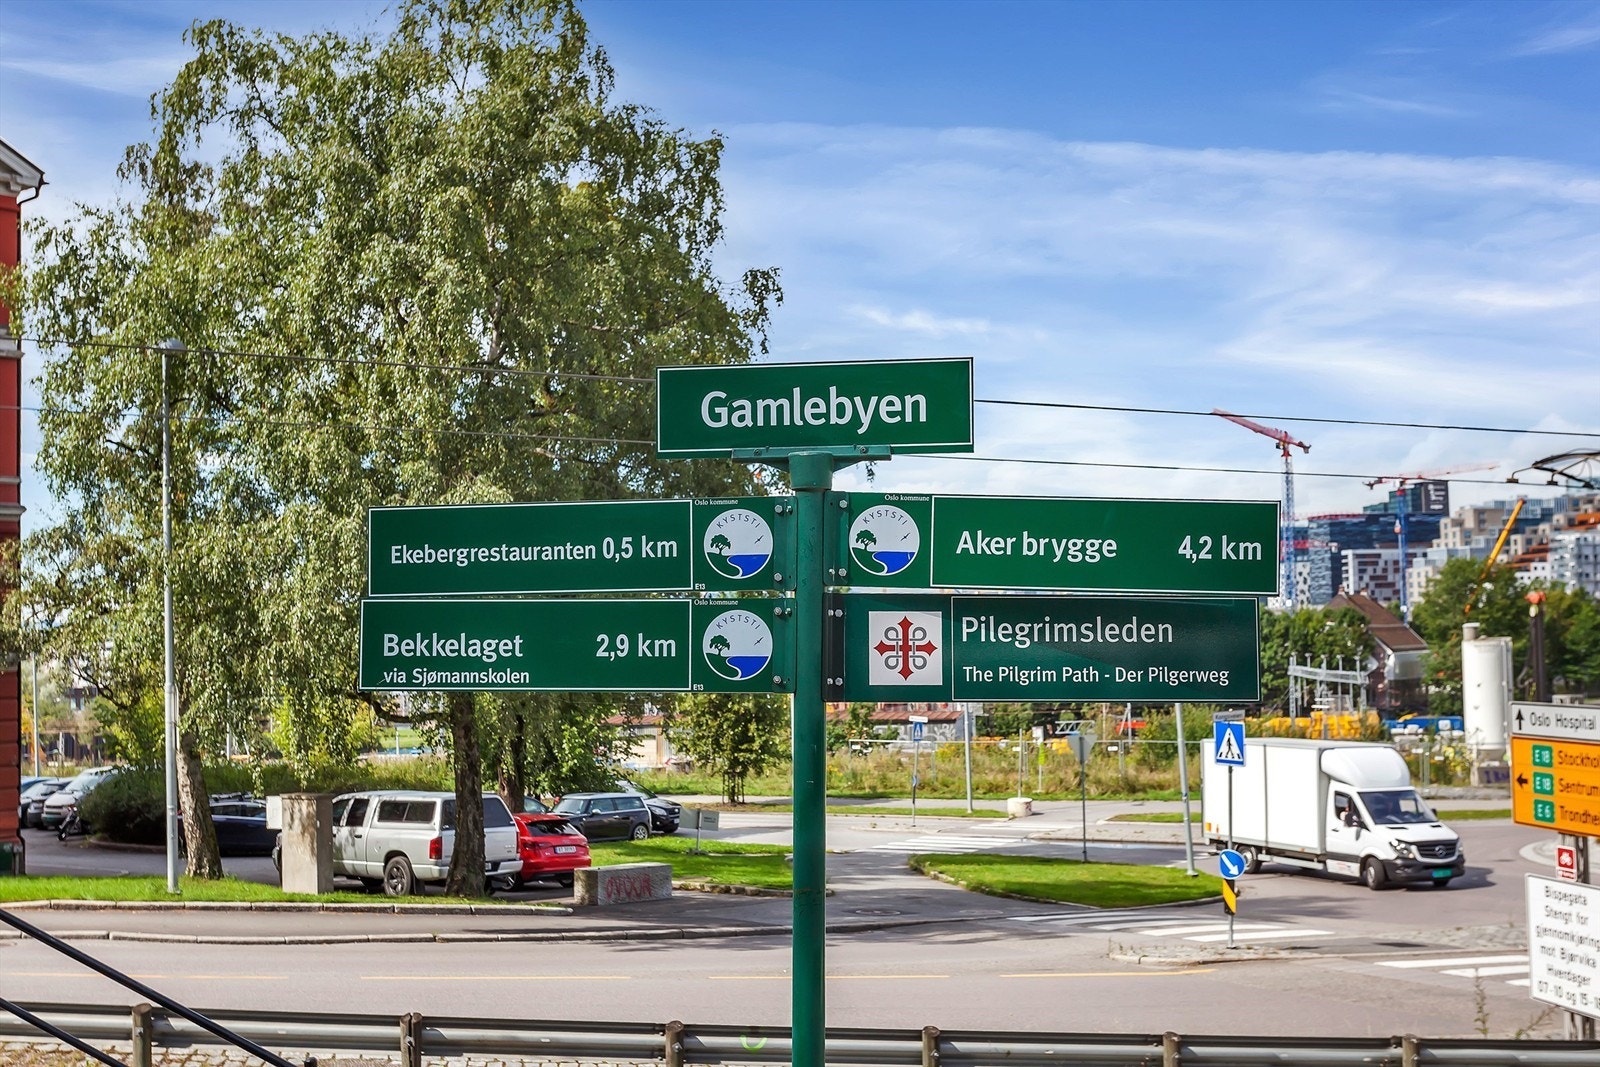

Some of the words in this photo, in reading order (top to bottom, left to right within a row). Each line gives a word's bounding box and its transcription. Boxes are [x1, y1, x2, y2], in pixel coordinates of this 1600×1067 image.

[701, 385, 927, 435] Gamlebyen
[716, 513, 761, 529] KYSTSTI
[862, 509, 908, 525] KYSTSTI
[391, 542, 596, 567] Ekebergrestauranten
[602, 536, 633, 563] 0,5
[641, 534, 678, 558] km
[955, 529, 1017, 556] Aker
[1022, 530, 1117, 563] brygge
[1178, 535, 1213, 564] 4,2
[1221, 534, 1262, 561] km
[715, 614, 761, 630] KYSTSTI
[962, 615, 1173, 649] Pilegrimsleden
[383, 632, 524, 663] Bekkelaget
[595, 633, 629, 662] 2,9
[638, 632, 676, 657] km
[383, 667, 407, 684] via
[412, 667, 530, 687] Sjømannskolen
[962, 665, 994, 683] The
[998, 665, 1057, 686] Pilgrim
[1062, 665, 1099, 683] Path
[1115, 666, 1144, 683] Der
[1148, 666, 1230, 687] Pilgerweg
[693, 683, 704, 691] E13
[1530, 711, 1551, 726] Oslo
[1555, 713, 1596, 732] Hospital
[1537, 803, 1543, 817] E
[1544, 804, 1551, 818] 6
